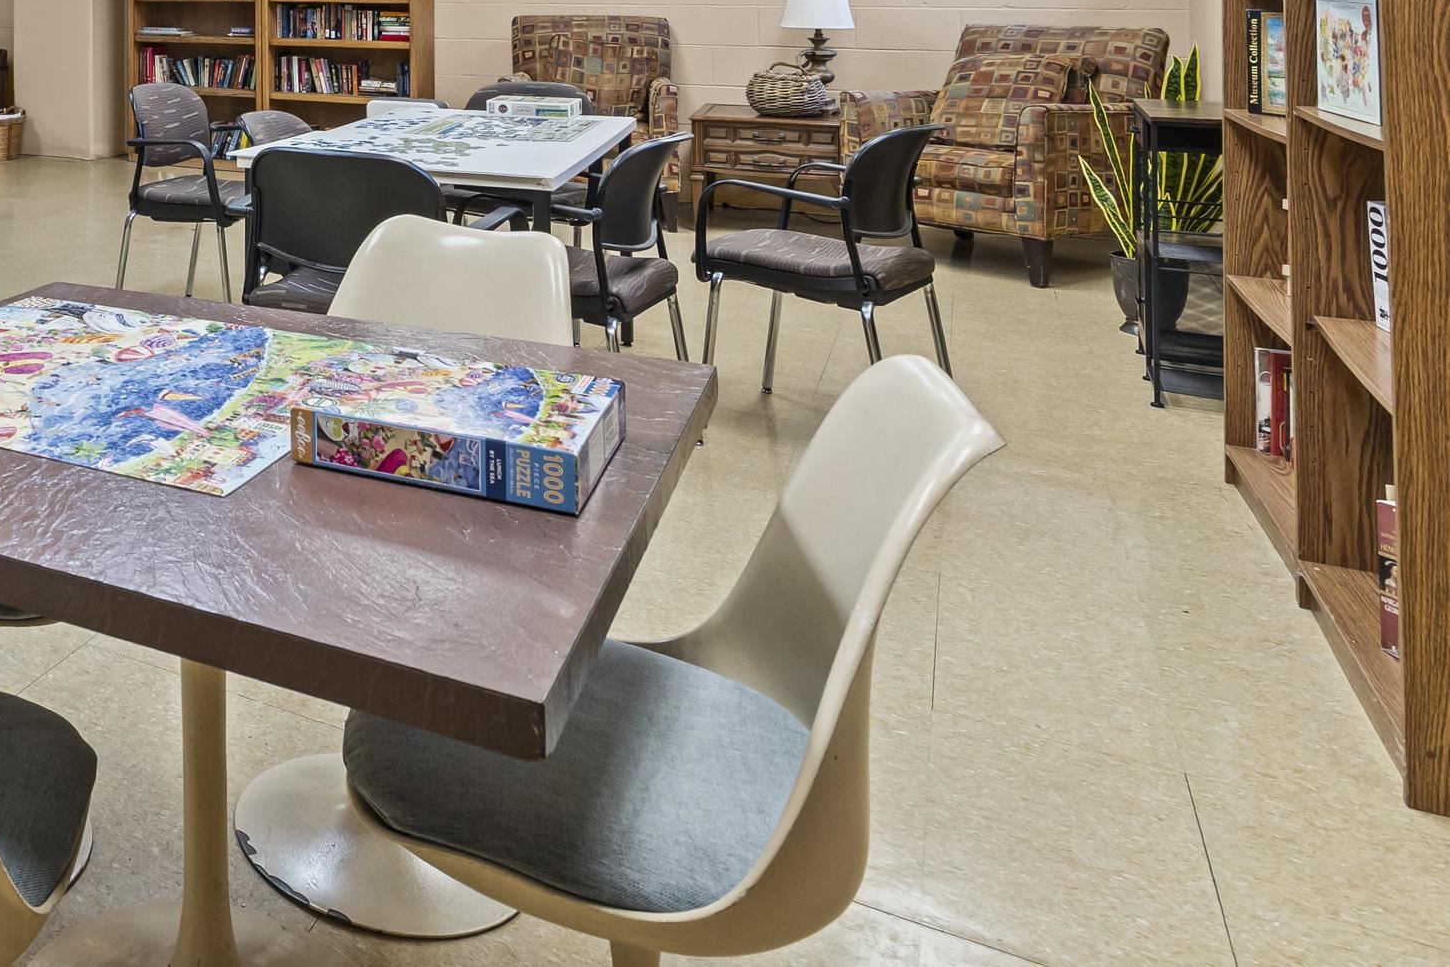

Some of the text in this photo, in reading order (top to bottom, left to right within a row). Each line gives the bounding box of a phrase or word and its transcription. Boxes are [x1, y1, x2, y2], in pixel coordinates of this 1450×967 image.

[1249, 18, 1259, 105] Museum Collection
[1369, 206, 1389, 283] 1000
[516, 449, 532, 499] PUZZLE
[543, 454, 565, 505] 1000
